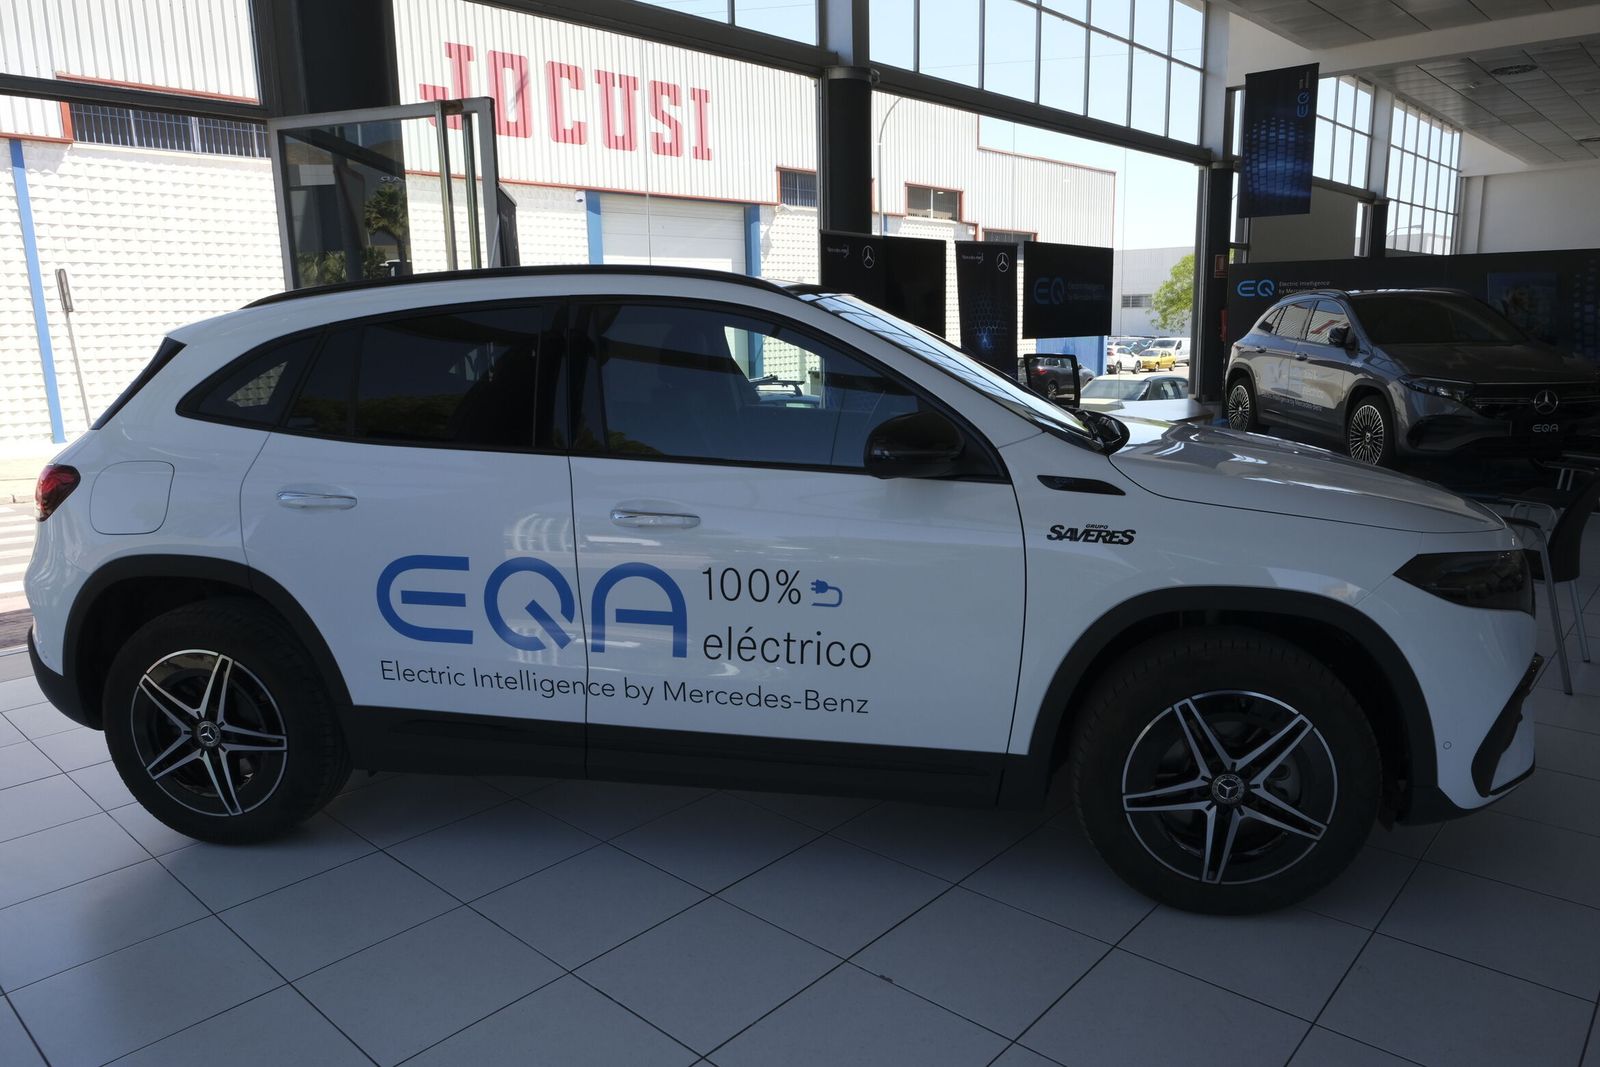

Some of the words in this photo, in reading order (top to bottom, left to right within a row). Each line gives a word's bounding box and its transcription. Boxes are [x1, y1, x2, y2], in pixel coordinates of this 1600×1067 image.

[419, 41, 712, 161] JOCUSI
[1236, 279, 1275, 298] EQ
[1532, 423, 1560, 433] EQA
[1046, 524, 1137, 546] SAVERES
[702, 566, 802, 605] 100%
[376, 554, 688, 659] EQA
[703, 626, 872, 669] eléctrico
[380, 660, 467, 687] Electric
[473, 667, 616, 699] Intelligence
[624, 676, 655, 706] by
[663, 680, 870, 715] Mercedes-Benz
